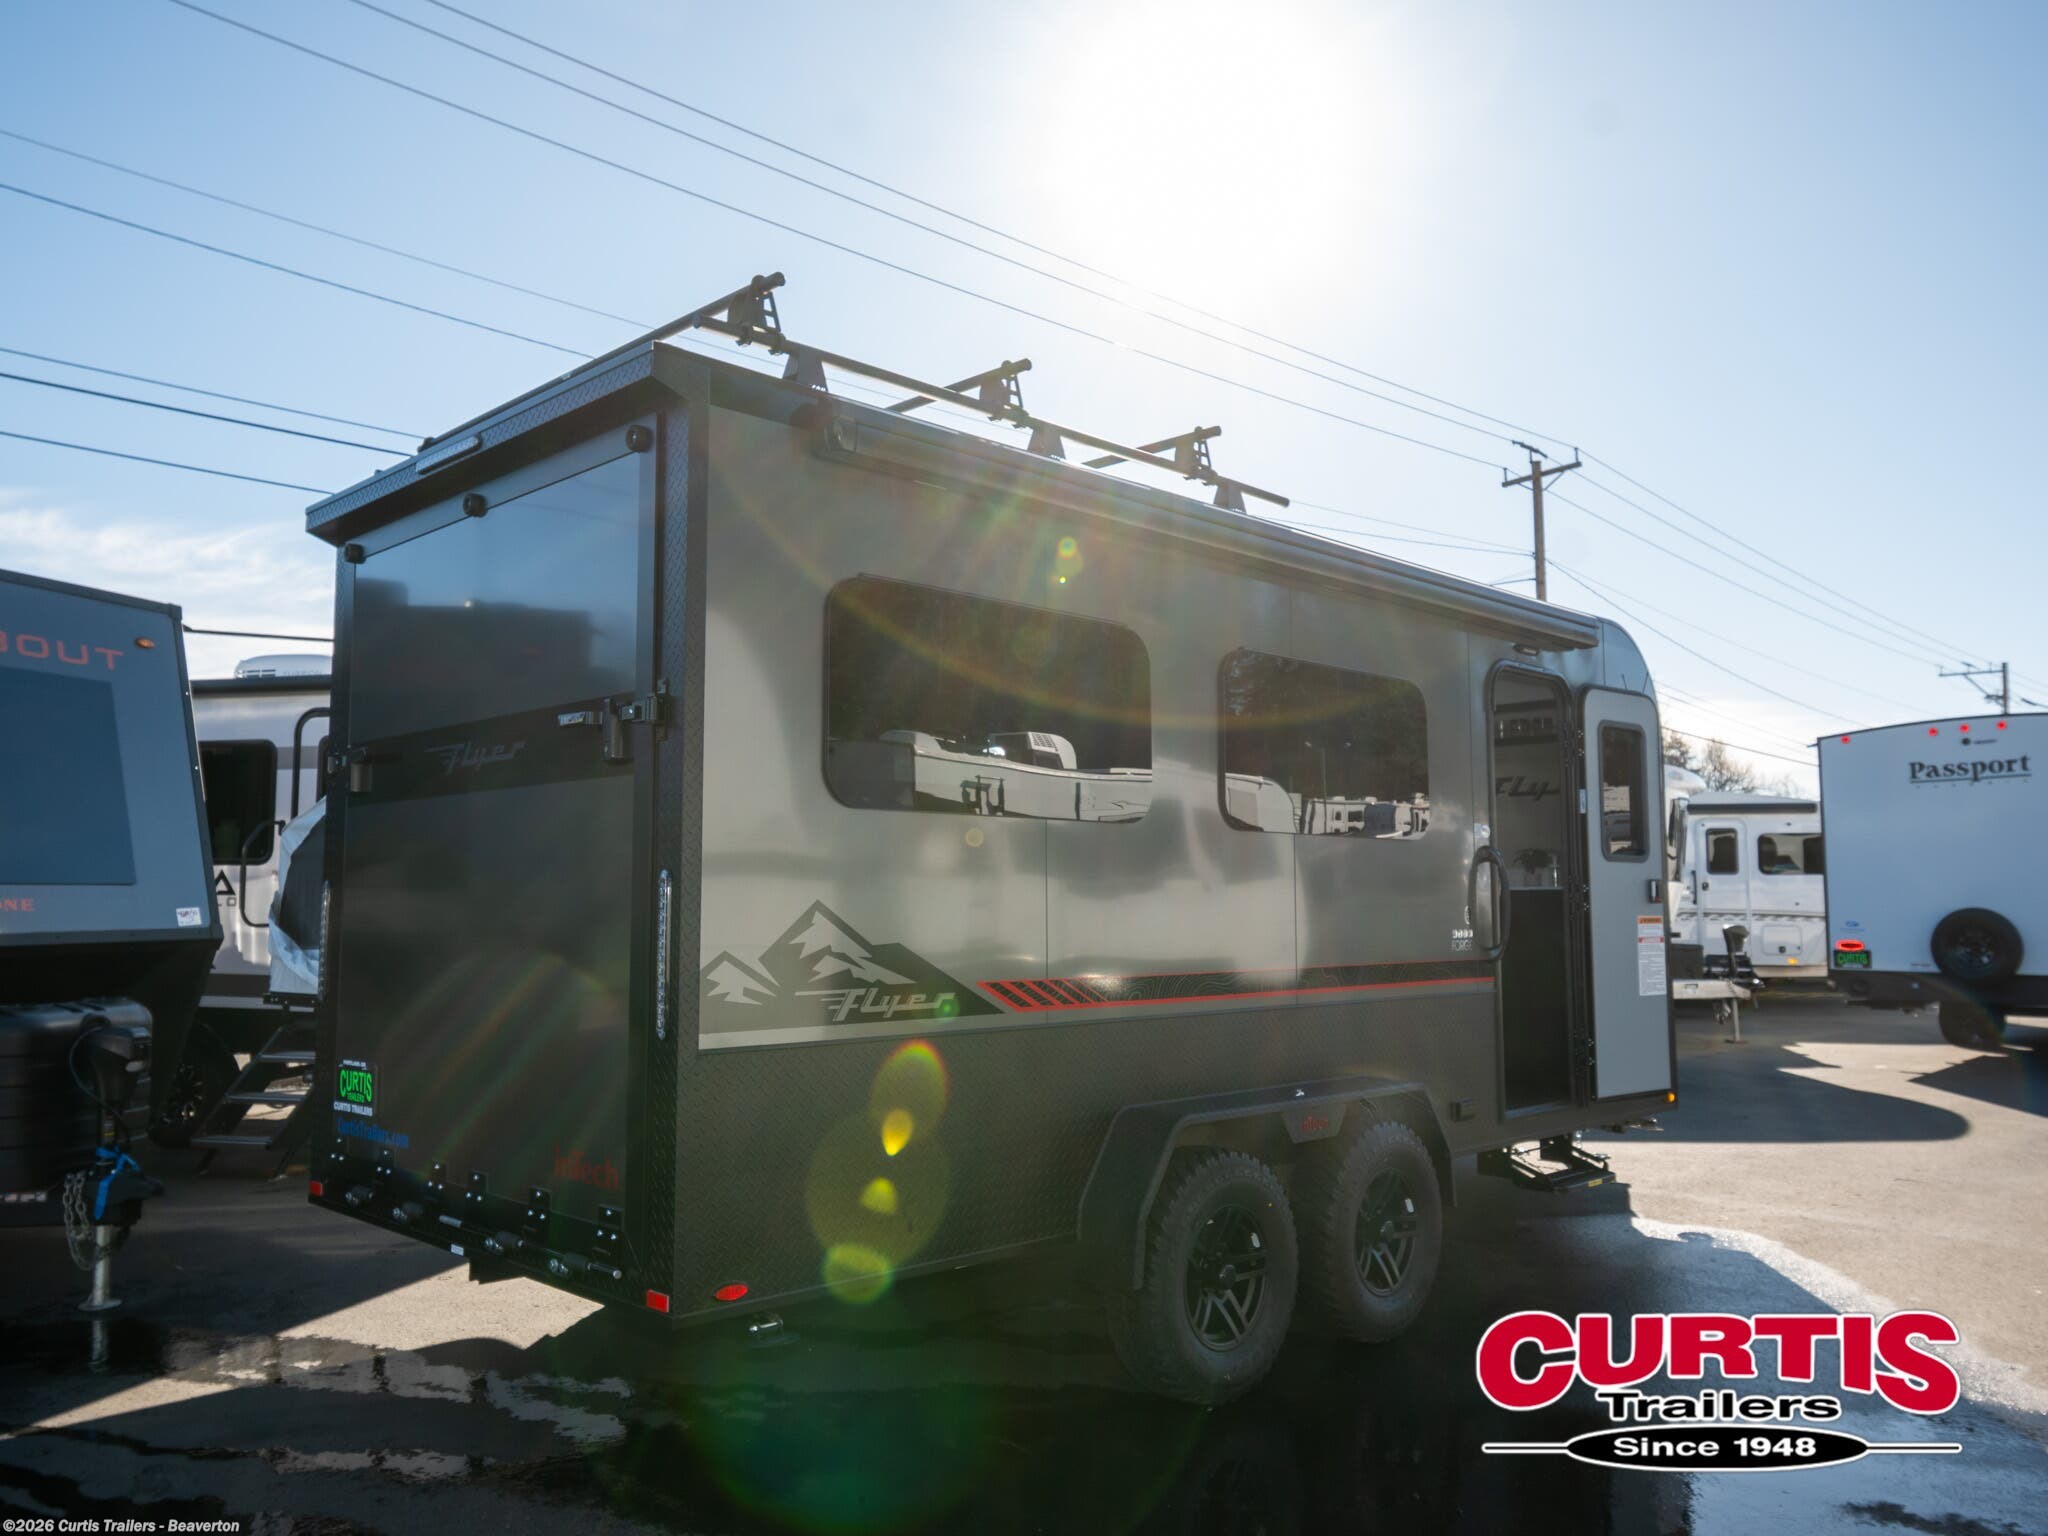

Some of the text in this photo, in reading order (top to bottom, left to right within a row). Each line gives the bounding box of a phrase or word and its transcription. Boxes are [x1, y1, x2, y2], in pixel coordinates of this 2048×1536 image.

[0, 630, 124, 671] OUT
[1908, 754, 2031, 783] Passport
[0, 897, 36, 912] NE
[795, 987, 956, 1021] Flyer
[339, 1069, 373, 1102] CURTIS
